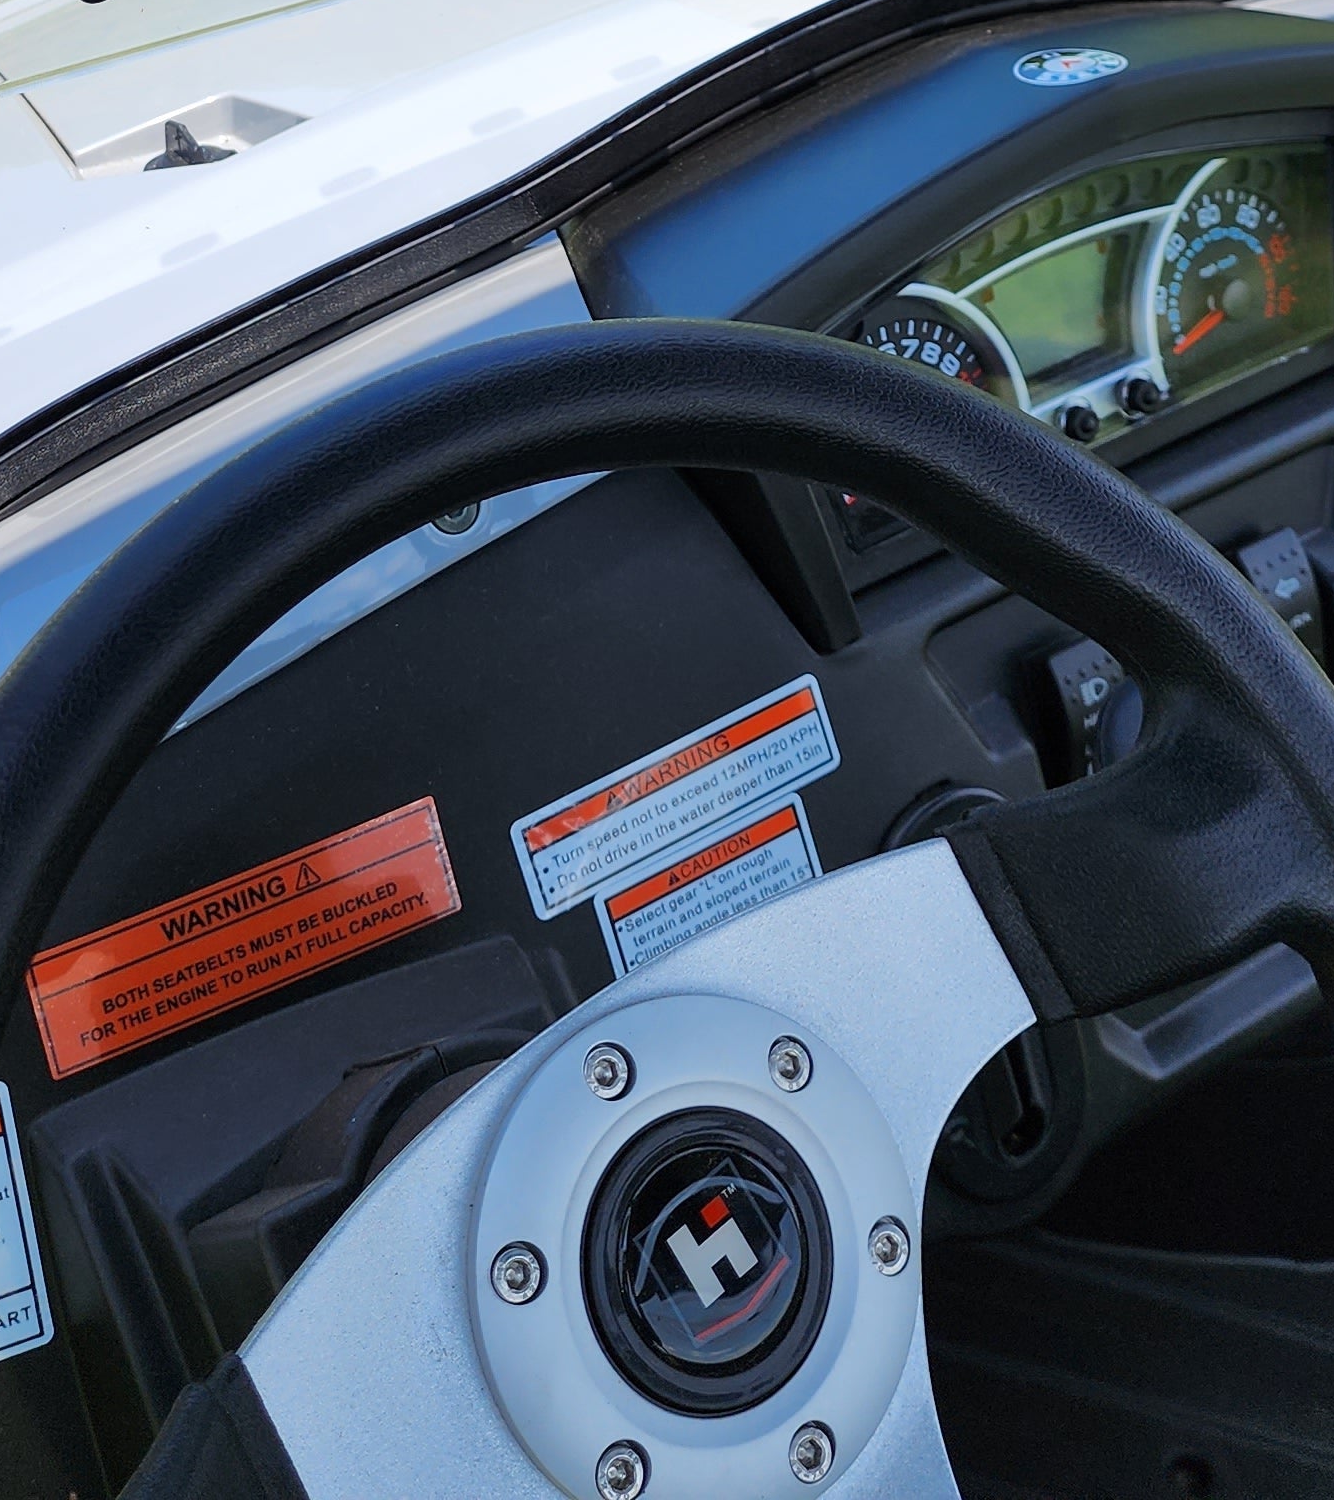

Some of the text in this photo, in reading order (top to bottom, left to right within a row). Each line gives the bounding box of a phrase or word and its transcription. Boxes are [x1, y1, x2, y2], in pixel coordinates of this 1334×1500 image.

[551, 844, 585, 869] Turn
[587, 819, 629, 853] speed
[631, 809, 654, 831] not
[655, 801, 668, 819] to
[671, 774, 719, 808] exceed
[789, 722, 819, 749] KPH
[622, 733, 732, 799] WARNING
[557, 871, 579, 890] Do
[581, 859, 604, 881] not
[605, 837, 639, 869] drive
[641, 830, 654, 848] in
[655, 817, 678, 841] the
[679, 799, 717, 828] water
[717, 777, 764, 809] deeper
[766, 761, 794, 787] than
[680, 834, 752, 879] CAUTION
[160, 874, 287, 941] WARNING
[624, 903, 668, 934] Select
[669, 890, 699, 914] gear
[736, 848, 774, 878] rough
[632, 857, 791, 948] terrain and sloped terrain
[732, 894, 760, 917] less
[760, 877, 788, 901] than
[80, 892, 430, 1047] FOR THE ENGINE TO RUN AT FULL CAPACITY.
[102, 881, 399, 1015] BOTH SEATBELTS MUST BE BUCKLED
